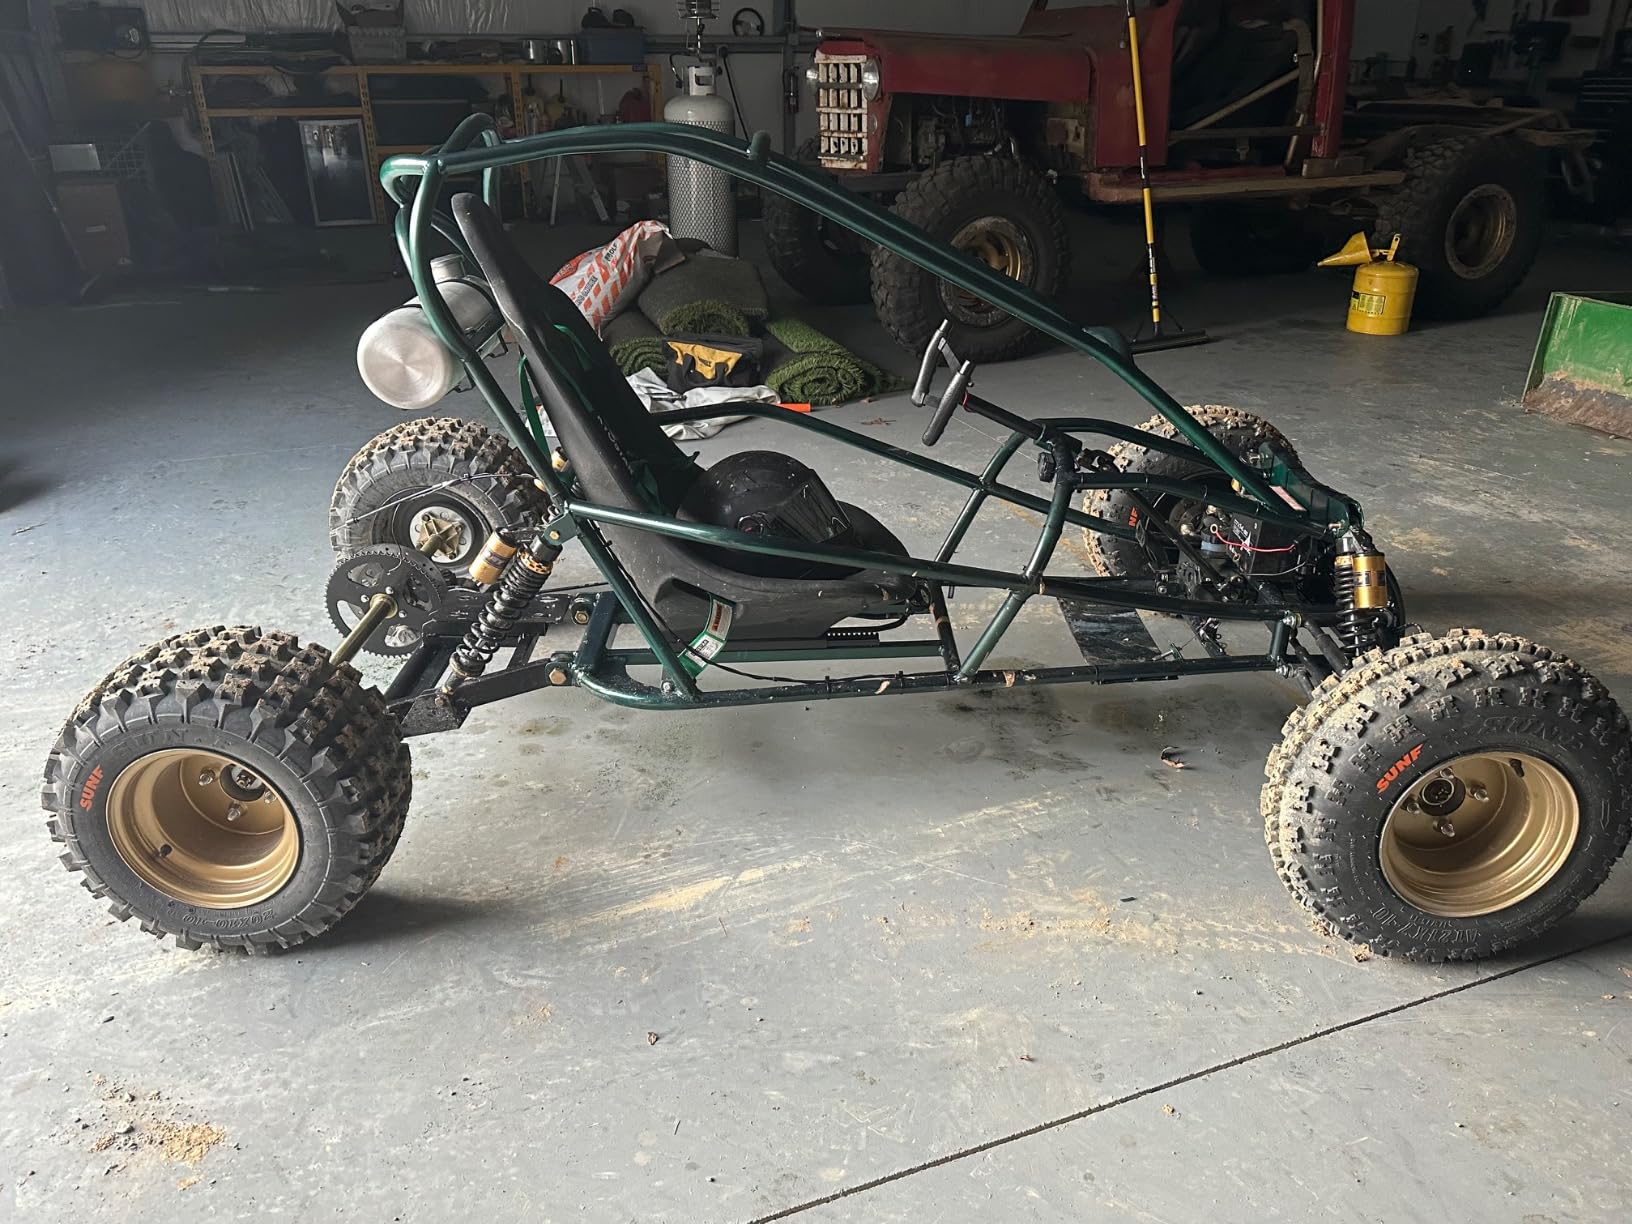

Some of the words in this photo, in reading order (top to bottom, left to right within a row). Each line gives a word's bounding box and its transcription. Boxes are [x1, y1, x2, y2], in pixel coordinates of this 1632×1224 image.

[1128, 506, 1139, 527] NF
[79, 763, 104, 812] SUNF
[1376, 742, 1424, 794] SUNF
